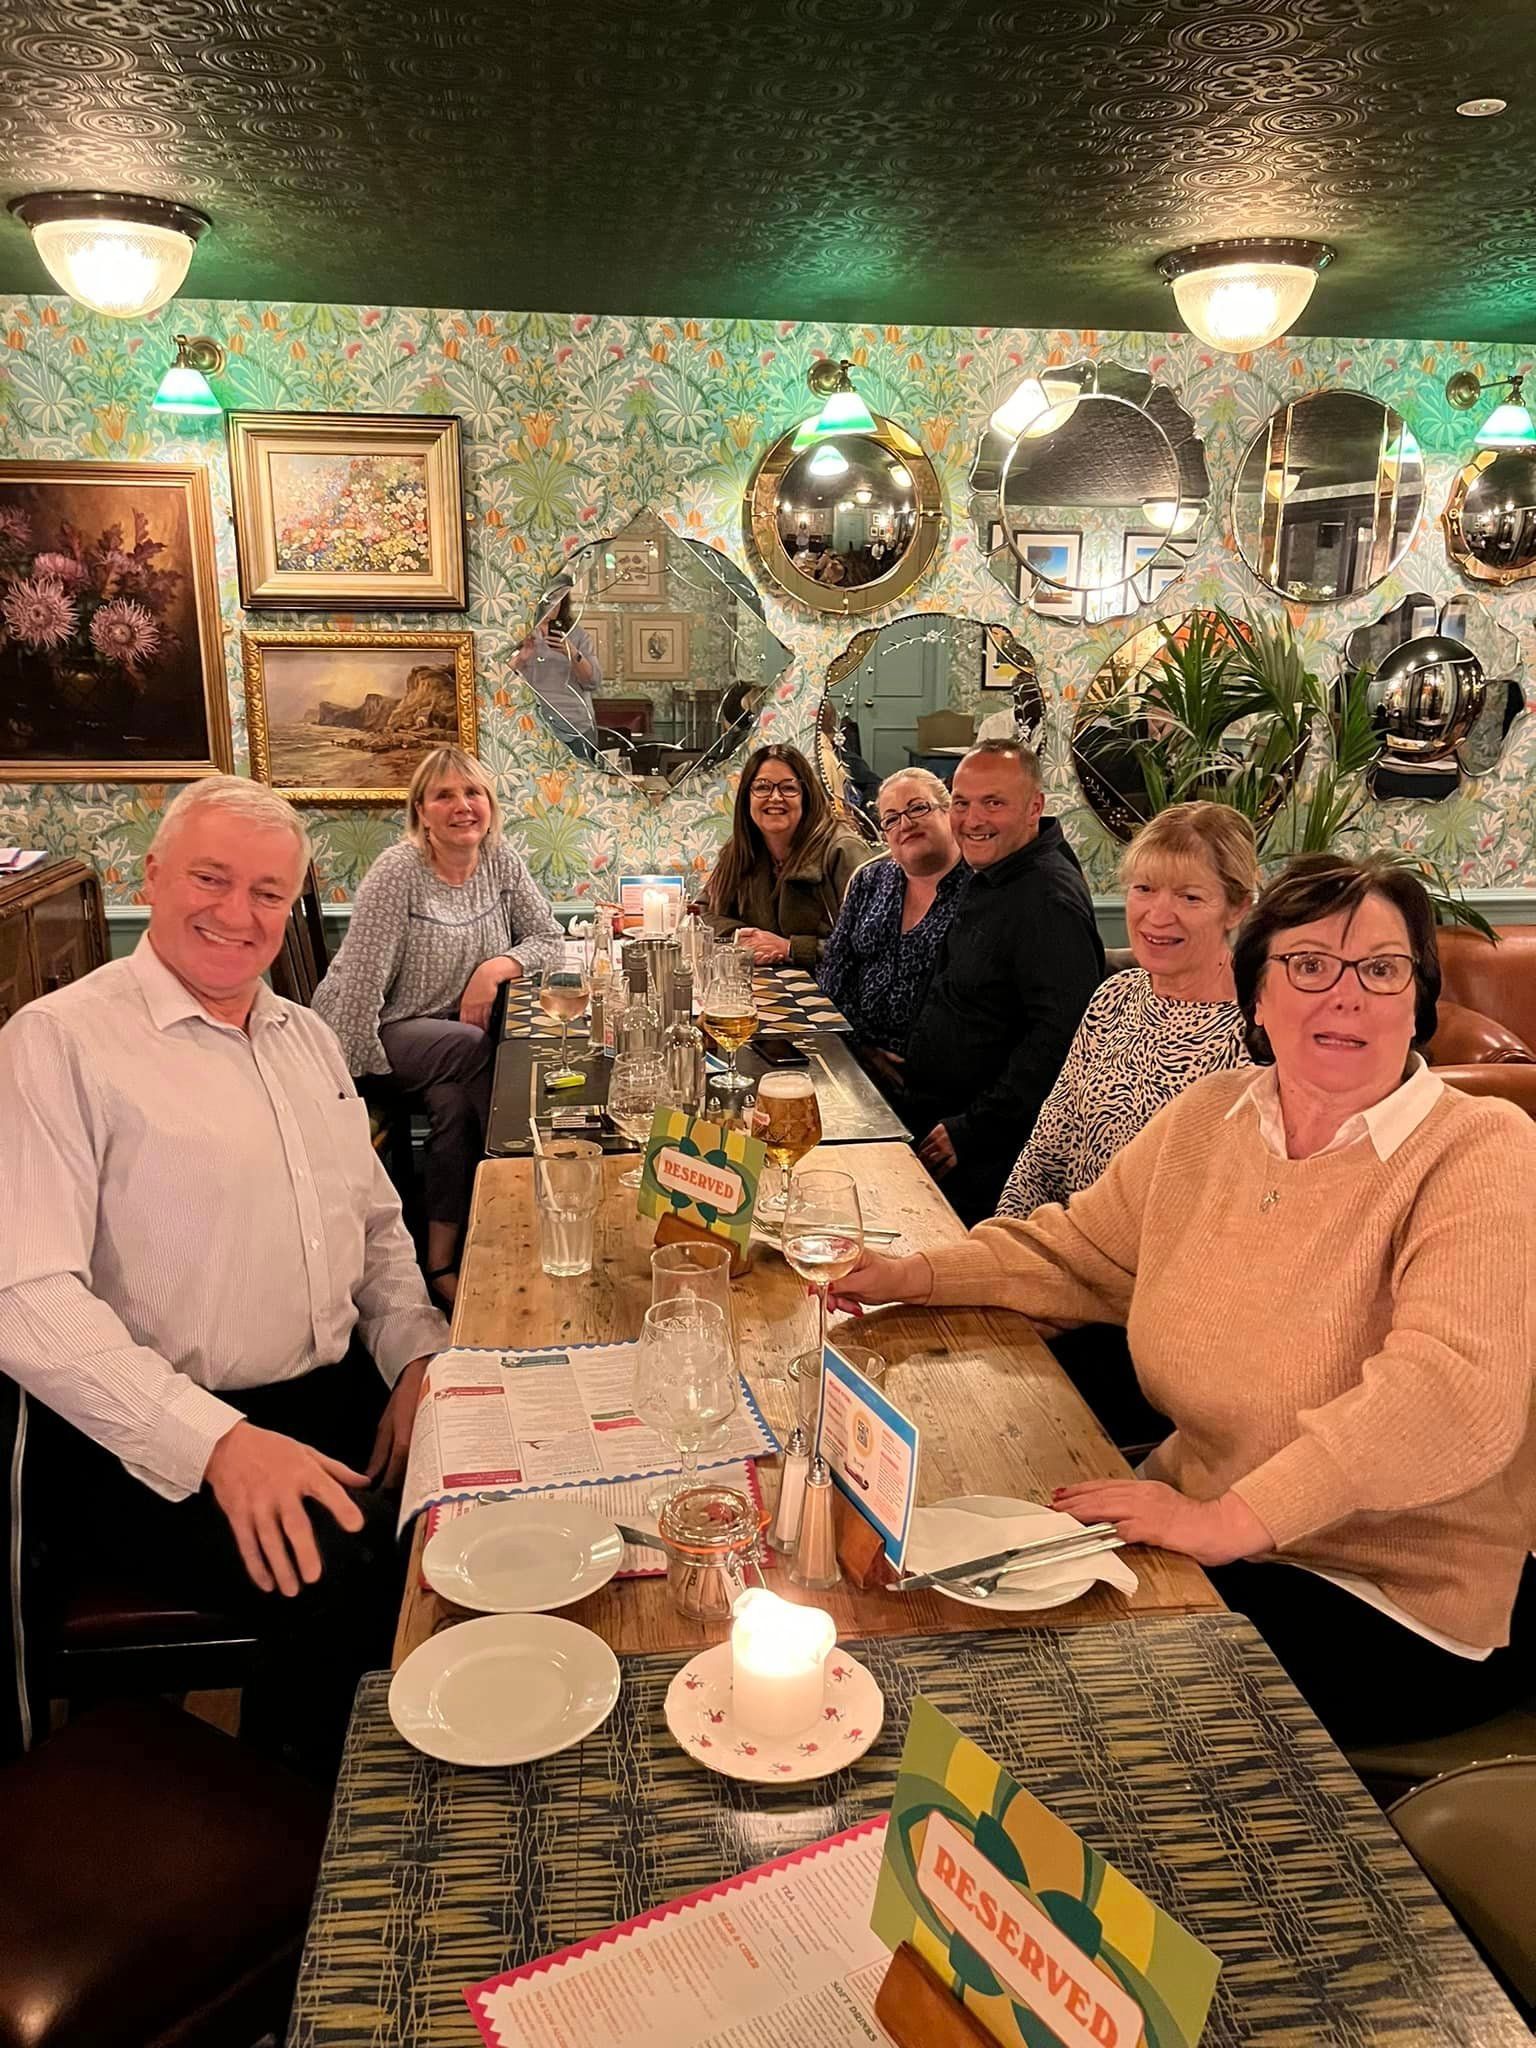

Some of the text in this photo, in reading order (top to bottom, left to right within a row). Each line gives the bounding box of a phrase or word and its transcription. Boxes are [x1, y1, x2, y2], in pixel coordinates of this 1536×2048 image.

[663, 1159, 734, 1199] RESERVED
[717, 1911, 737, 1936] BEER
[738, 1942, 760, 1969] CIDER
[932, 1845, 1119, 2048] RESERVED
[829, 1980, 852, 2004] SOFT
[849, 2005, 878, 2043] DRINKS
